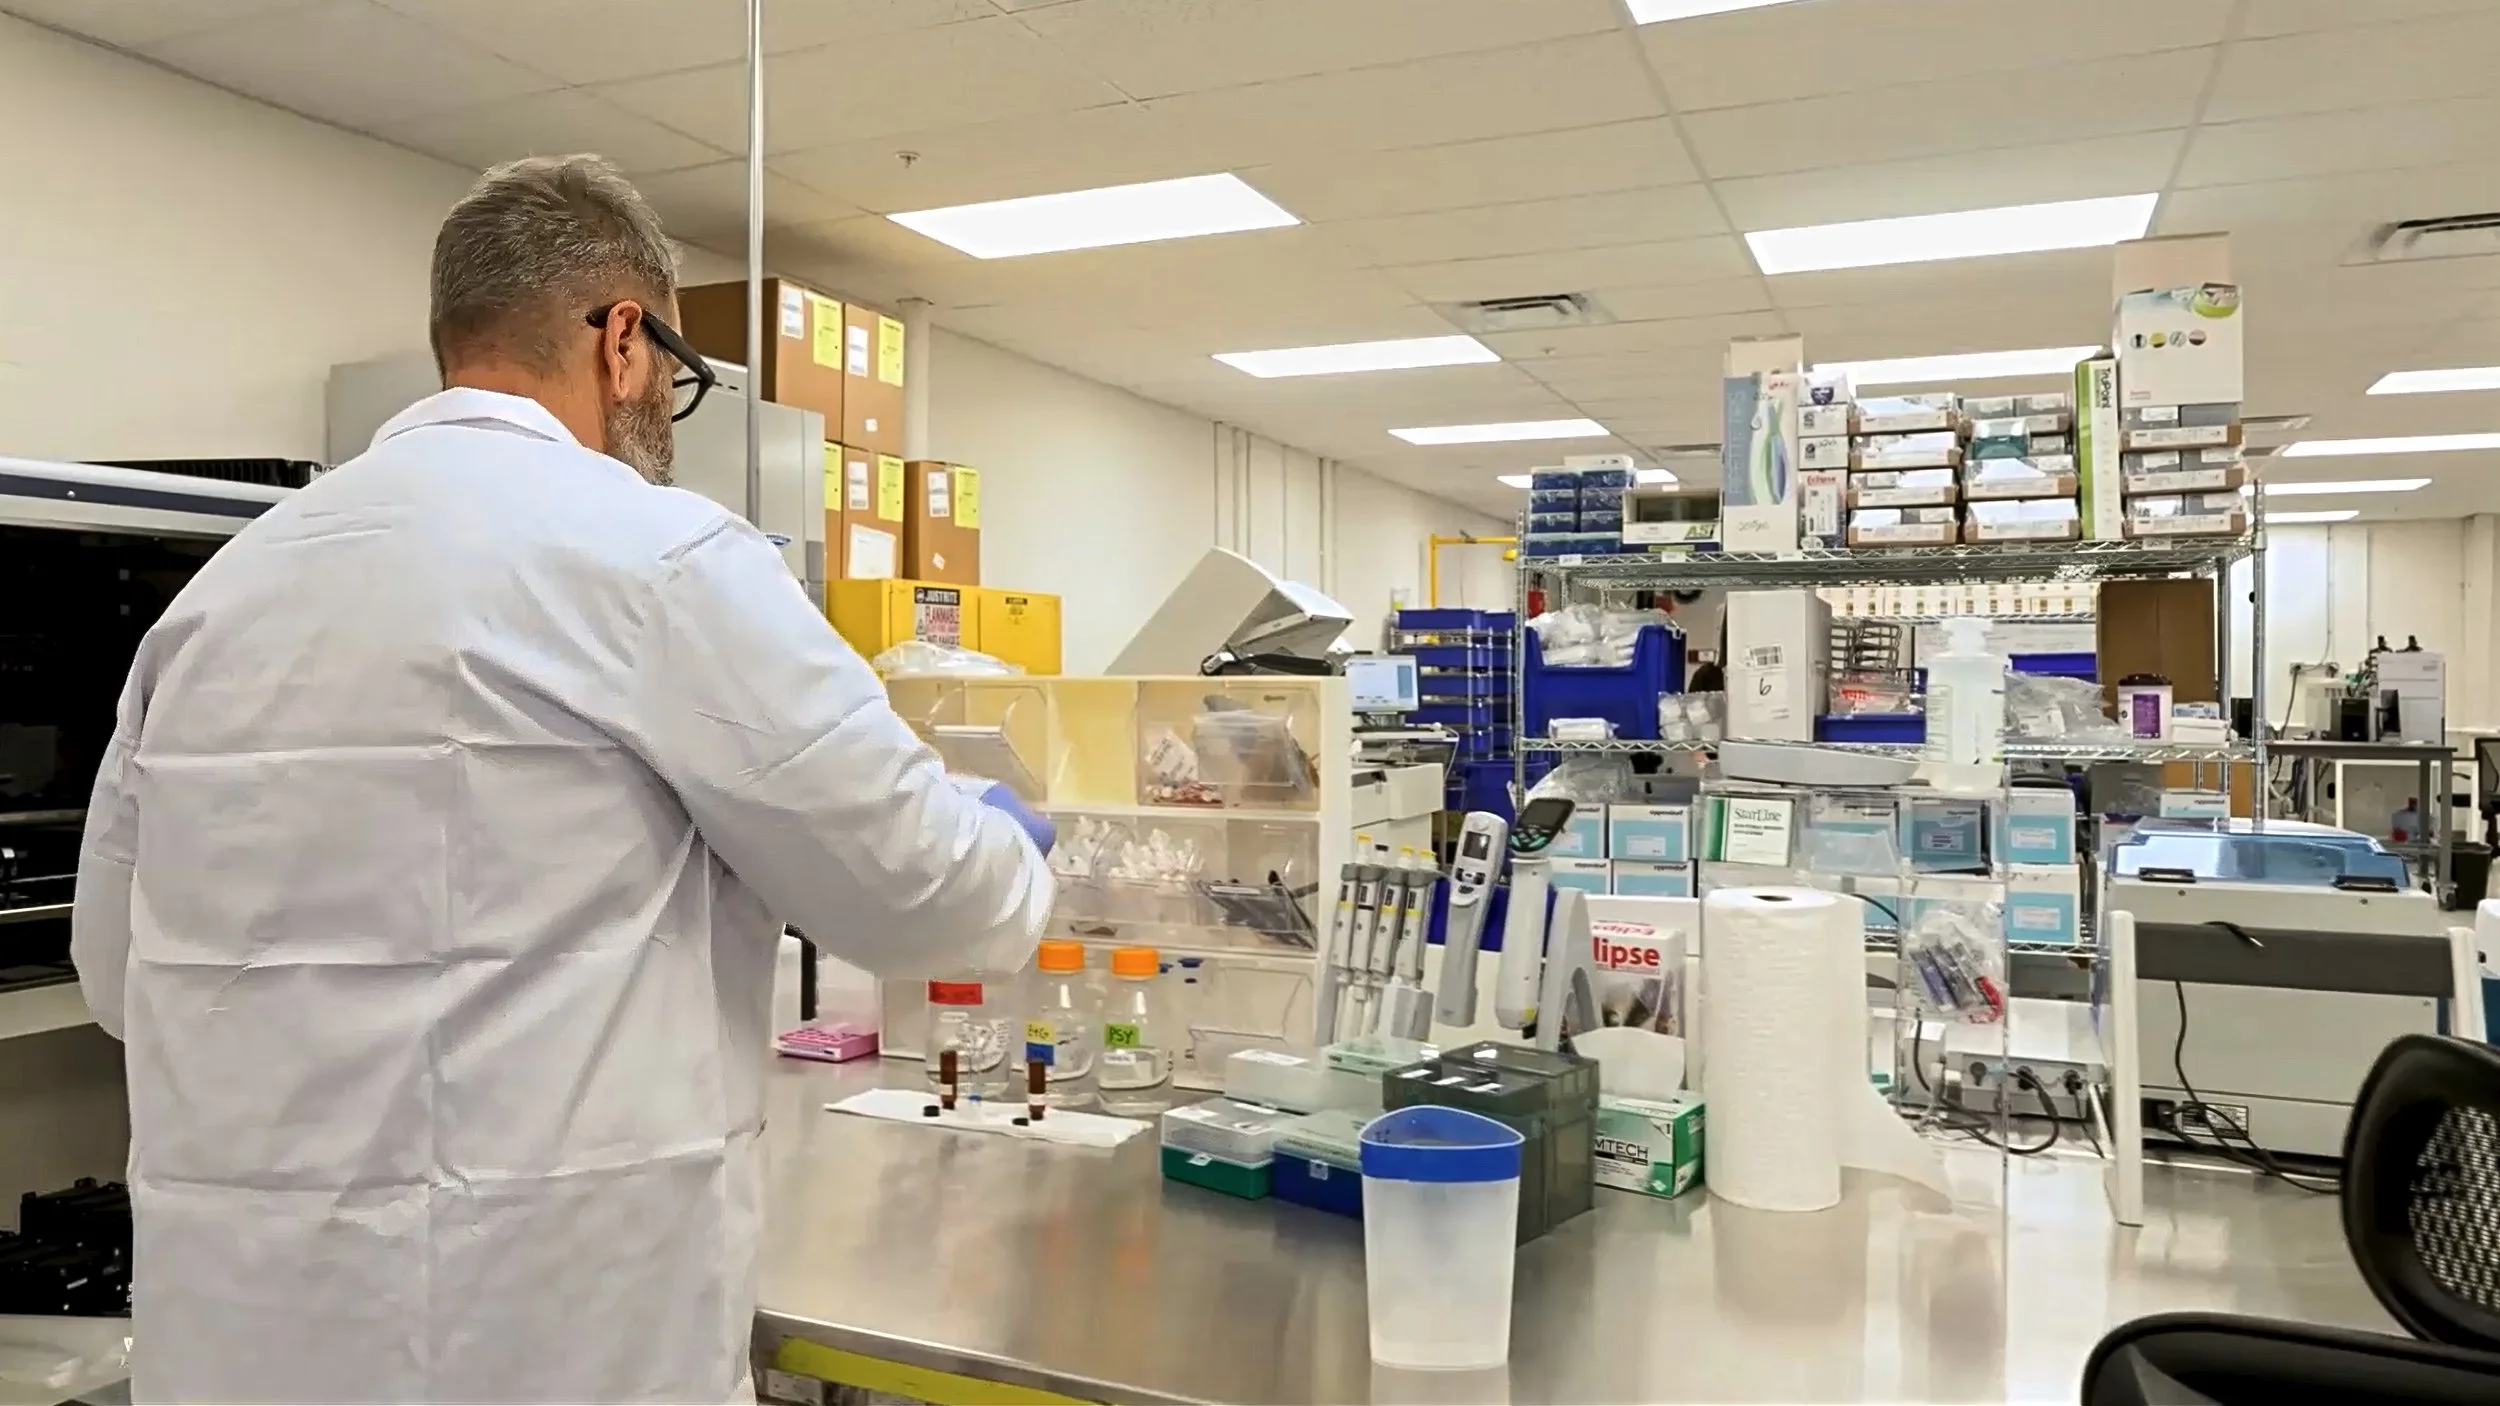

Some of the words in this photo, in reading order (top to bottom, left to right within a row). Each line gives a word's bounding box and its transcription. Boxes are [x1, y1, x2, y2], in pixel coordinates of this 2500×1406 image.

[1807, 475, 1836, 486] Eclipse
[1734, 807, 1782, 822] StarLine
[1592, 936, 1660, 968] lipse
[1109, 1027, 1134, 1044] PSY
[1595, 1138, 1649, 1159] MTECH
